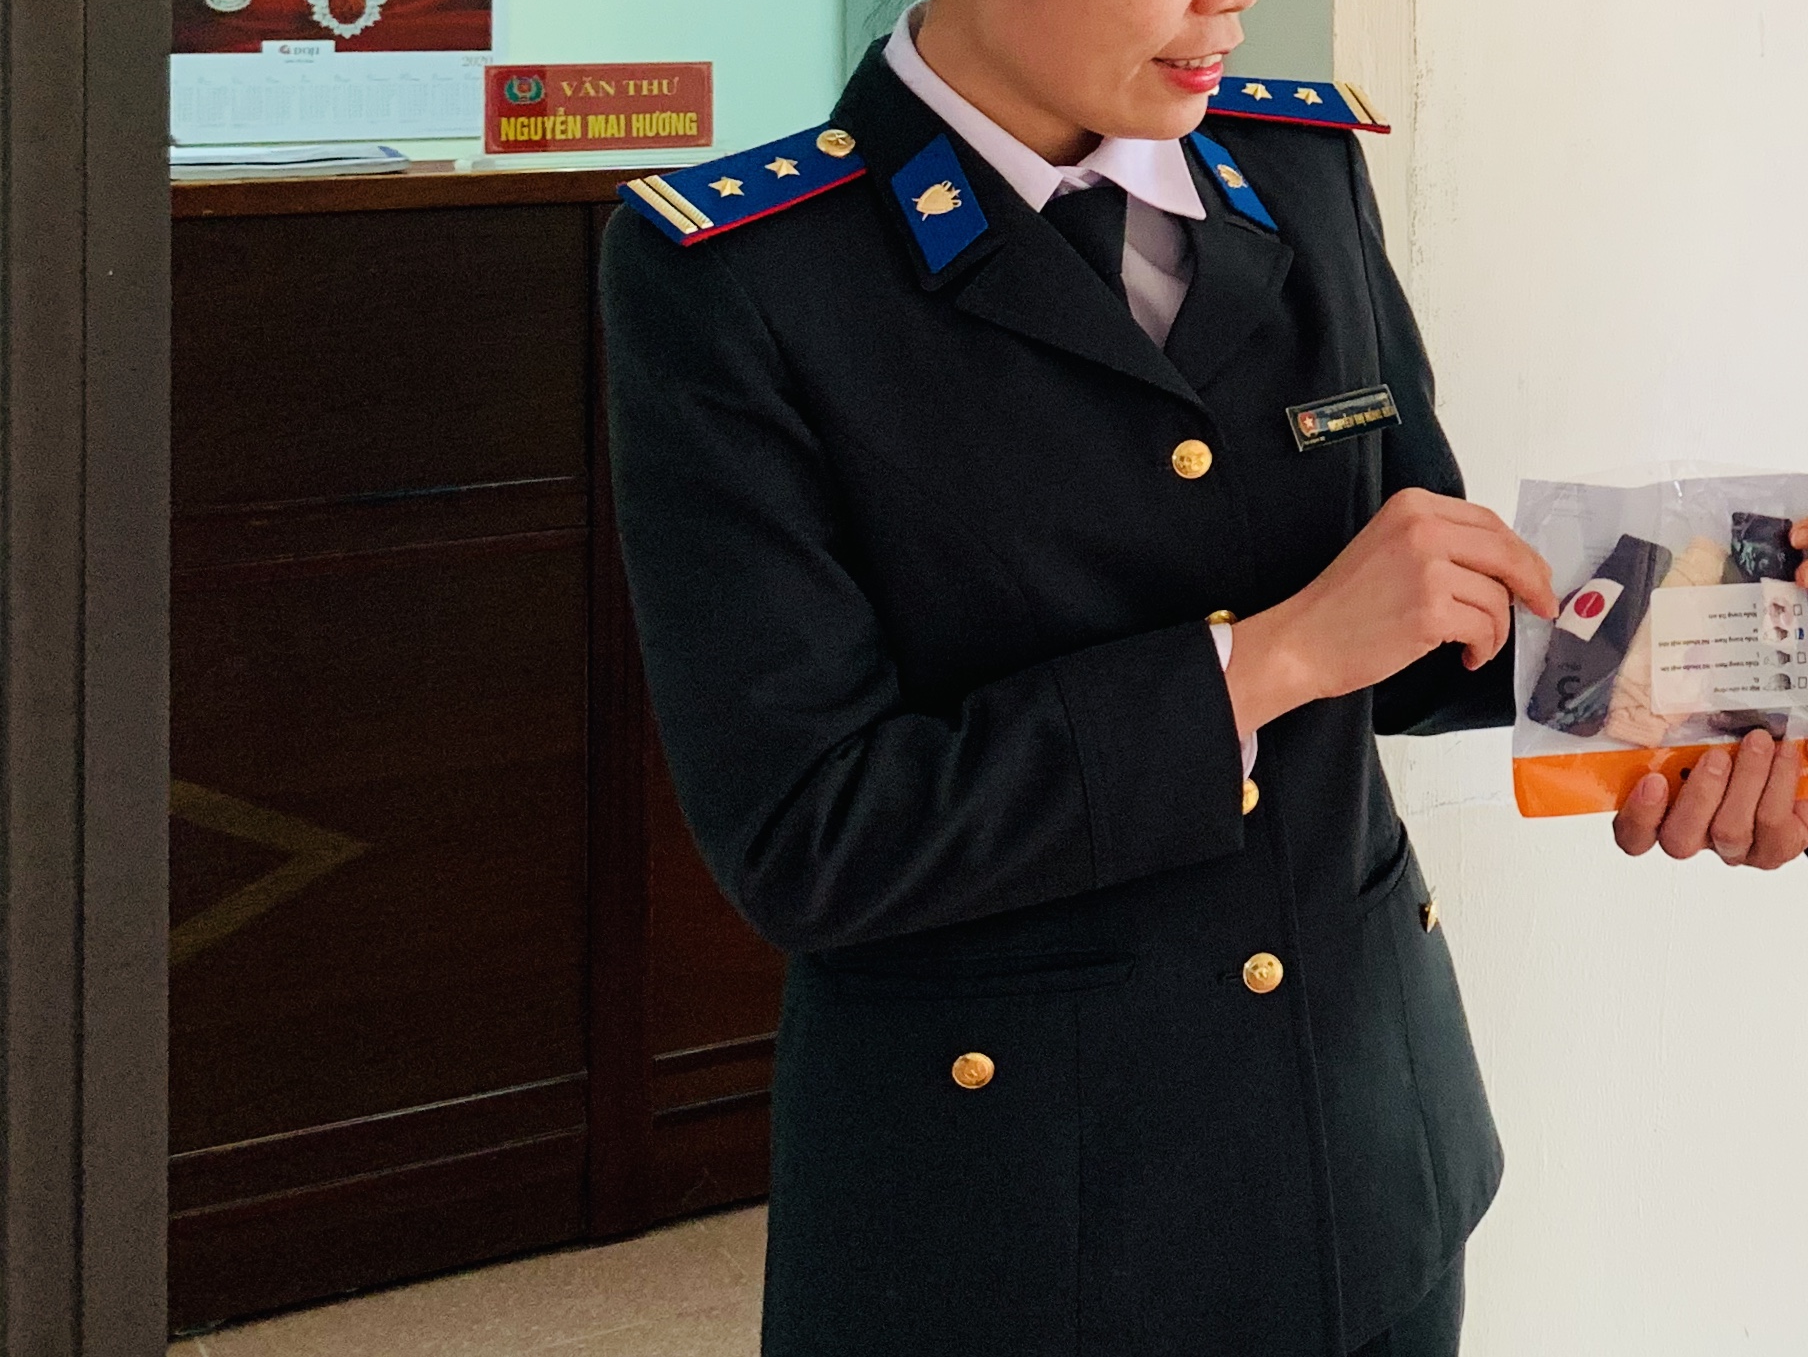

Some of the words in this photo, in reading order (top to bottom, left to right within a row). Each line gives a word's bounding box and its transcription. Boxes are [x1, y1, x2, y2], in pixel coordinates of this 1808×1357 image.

[560, 76, 616, 98] VĂN
[623, 76, 680, 96] THƯ
[500, 107, 582, 142] NGUYỄN
[587, 114, 626, 139] MAI
[631, 110, 698, 138] HƯƠNG
